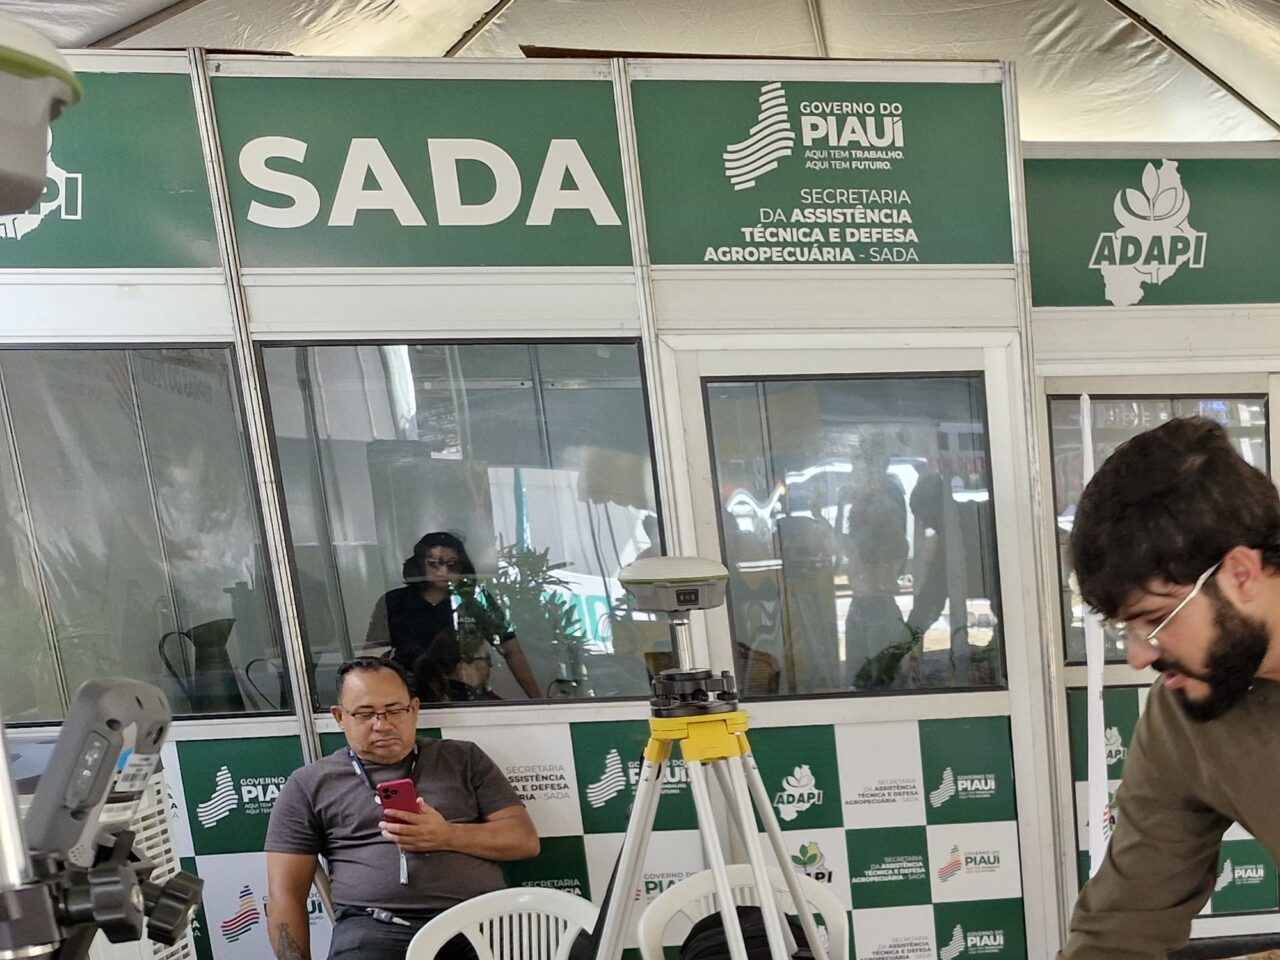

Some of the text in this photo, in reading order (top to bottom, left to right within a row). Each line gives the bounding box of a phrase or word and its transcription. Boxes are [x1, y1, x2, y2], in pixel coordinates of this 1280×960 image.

[800, 101, 903, 114] GOVERNO DO
[801, 115, 904, 147] PIAUÍ
[805, 150, 828, 159] AQUI
[830, 150, 849, 158] TEM
[806, 160, 829, 170] AQUI
[830, 161, 850, 169] TEM
[238, 136, 622, 228] SADA
[800, 188, 911, 204] SECRETARIA
[760, 205, 912, 223] DA ASSISTÊNCIA
[741, 225, 918, 243] TÉCNICA E DEFESA
[704, 244, 855, 262] AGROPECUÁRIA
[869, 247, 919, 262] SADA
[1090, 233, 1207, 268] ADAPI
[506, 765, 564, 774] SECRETARIA
[240, 776, 285, 785] GOVERNO
[508, 773, 566, 783] SSISTÊNCIA
[241, 785, 283, 803] PIA
[531, 783, 569, 791] DEFESA
[543, 792, 571, 800] SADA
[774, 790, 824, 806] ADAPI
